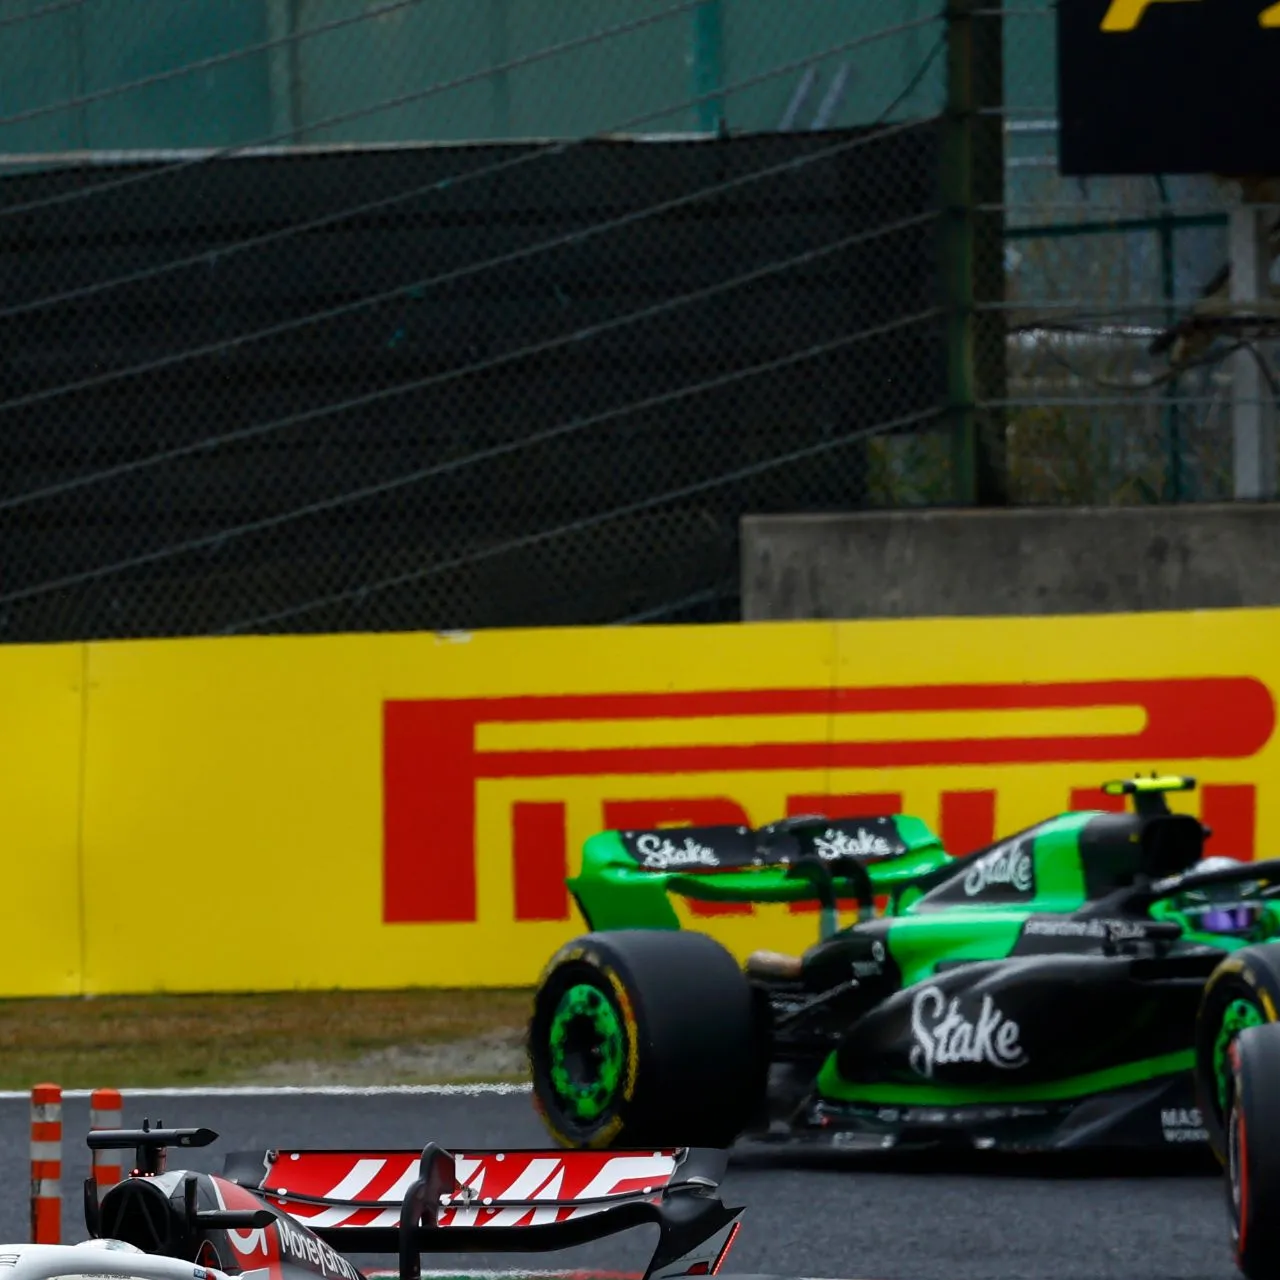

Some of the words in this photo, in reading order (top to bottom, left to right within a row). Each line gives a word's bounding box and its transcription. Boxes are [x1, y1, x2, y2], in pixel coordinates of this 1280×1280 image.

[636, 832, 720, 868] Stake
[814, 827, 893, 860] Stake
[909, 985, 1028, 1078] Stake
